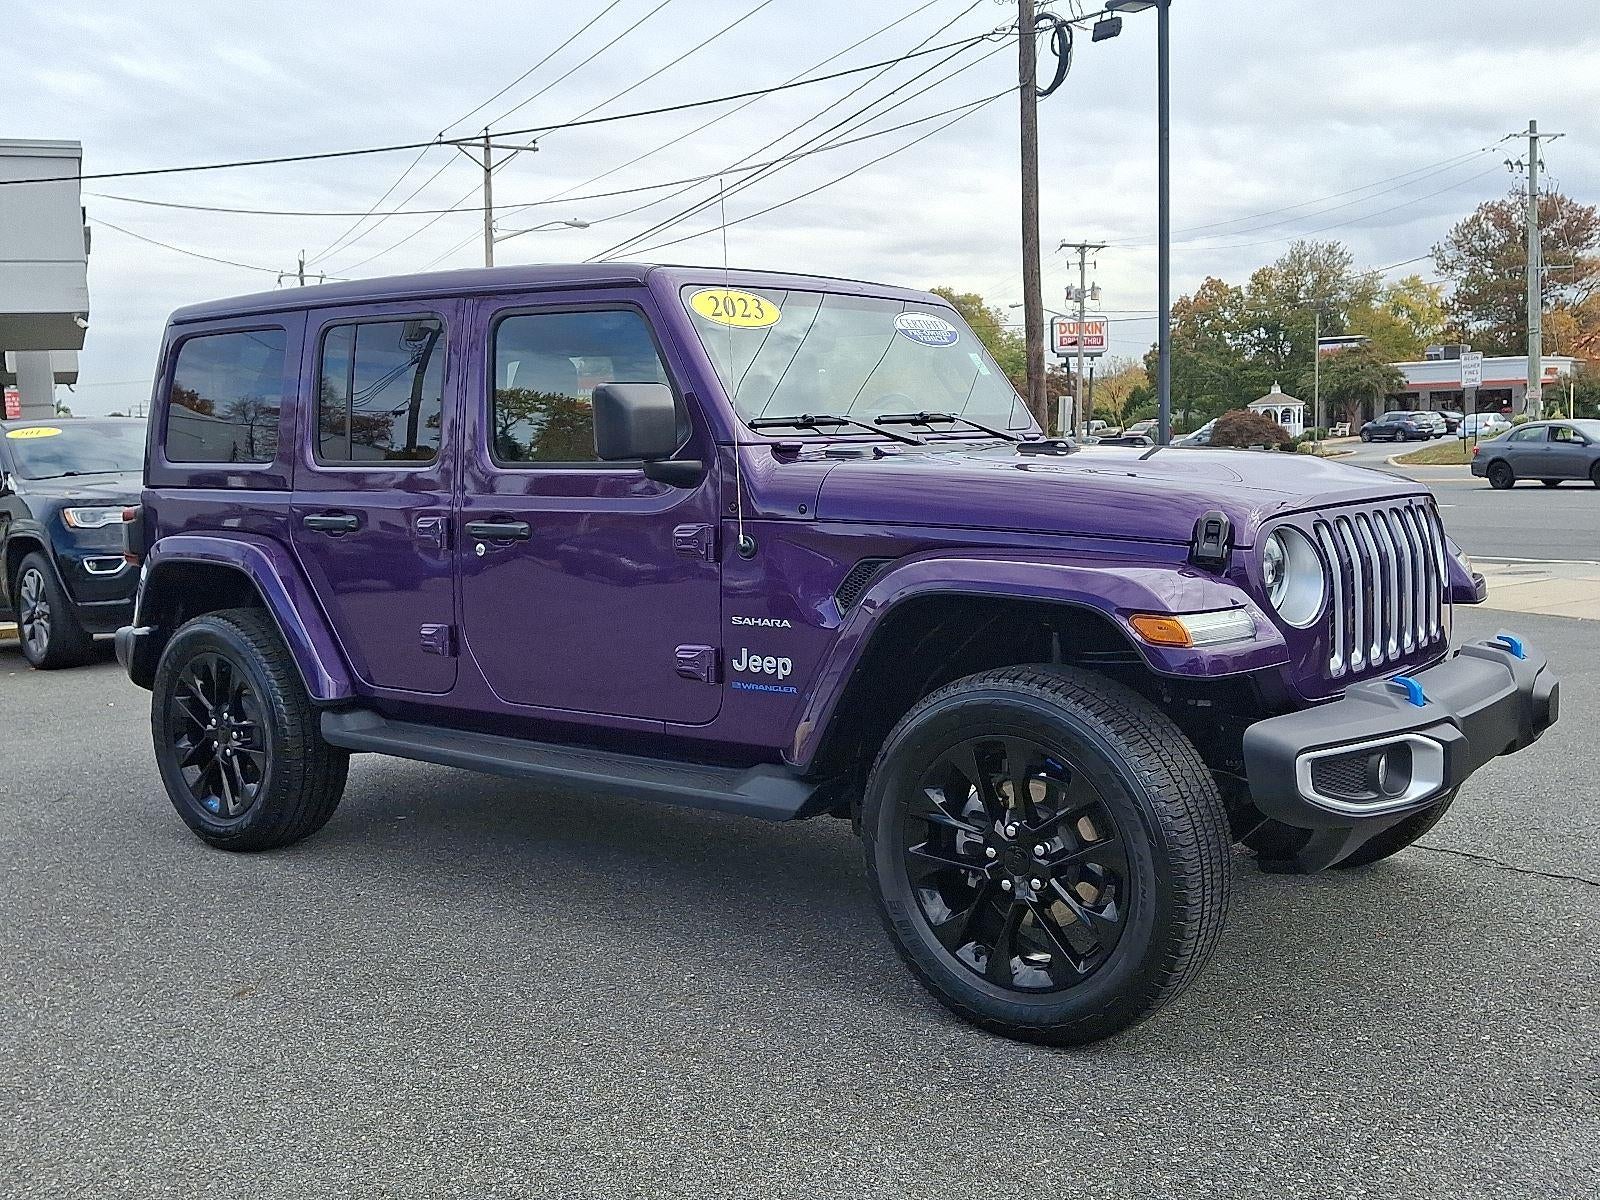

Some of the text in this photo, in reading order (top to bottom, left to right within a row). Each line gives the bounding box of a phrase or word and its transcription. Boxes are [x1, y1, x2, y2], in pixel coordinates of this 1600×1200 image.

[707, 295, 764, 319] 2023
[1084, 337, 1102, 345] THRU
[731, 616, 792, 629] SAHARA
[732, 647, 792, 680] Jeep
[741, 682, 798, 694] WRANGLER
